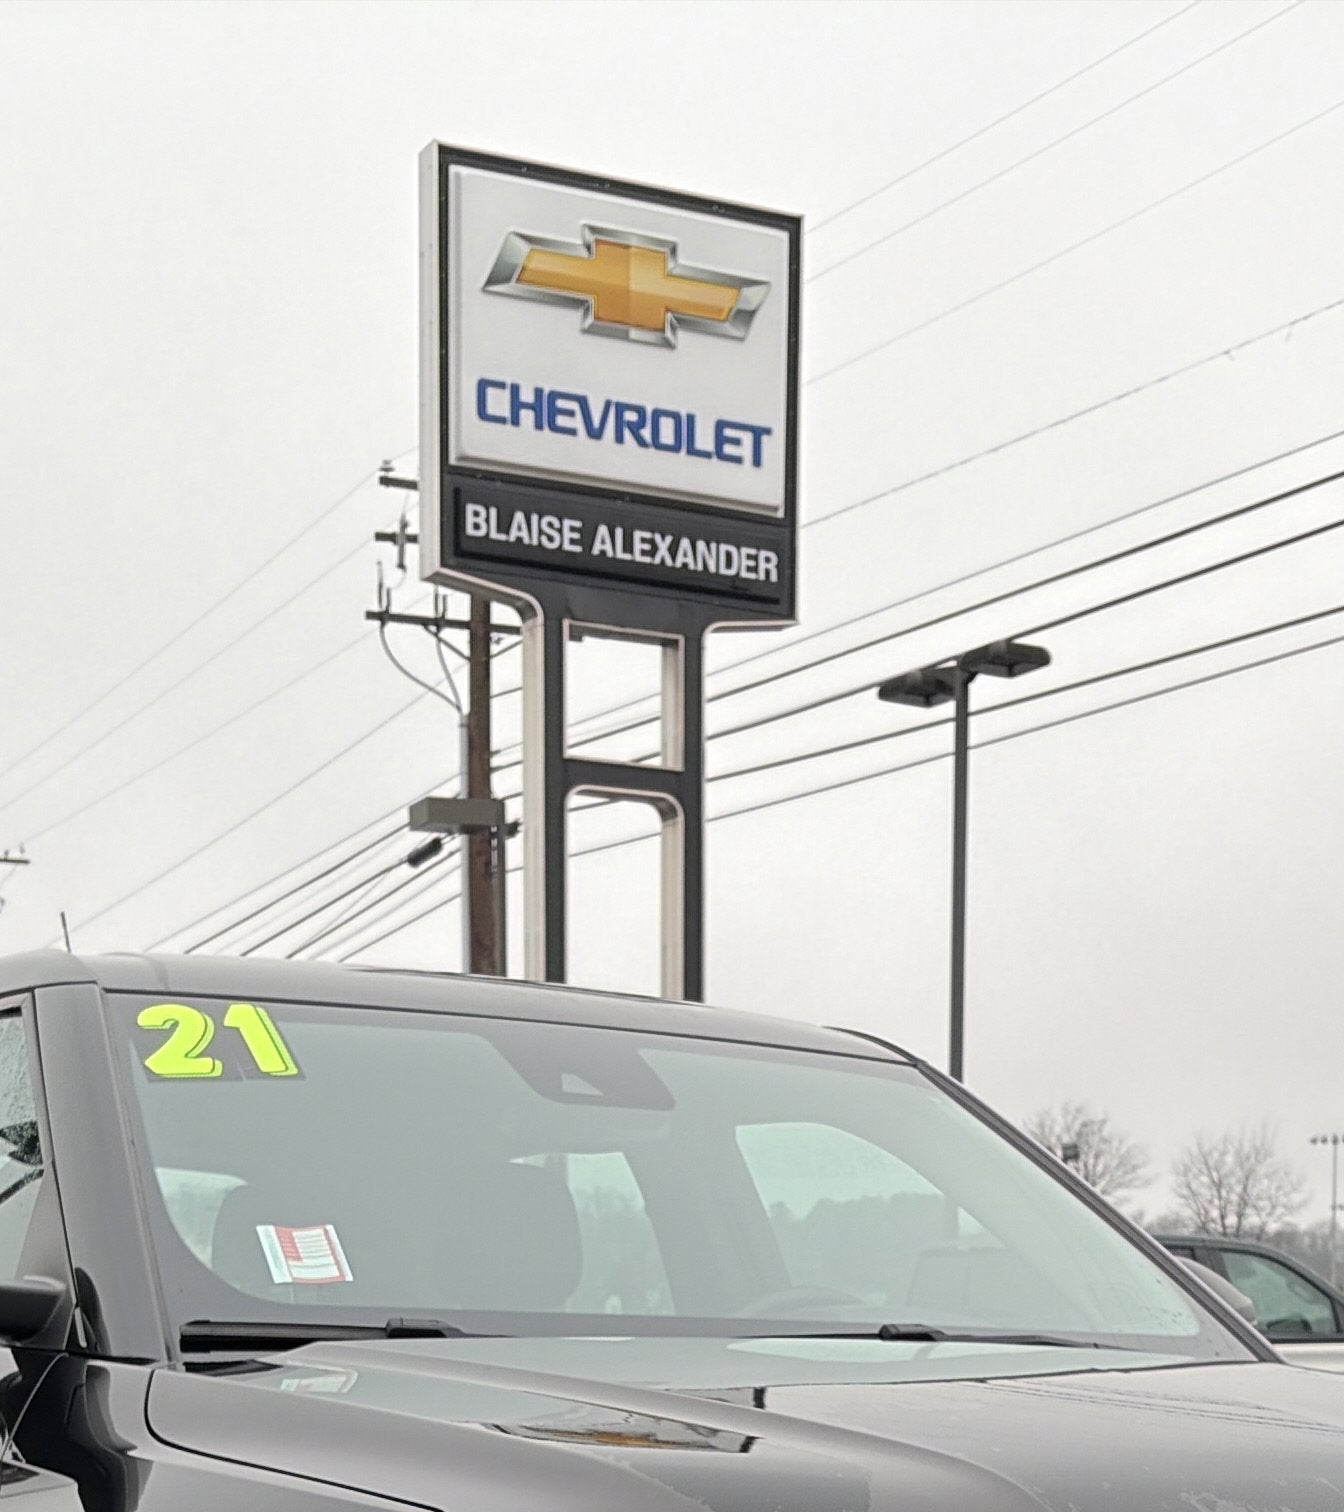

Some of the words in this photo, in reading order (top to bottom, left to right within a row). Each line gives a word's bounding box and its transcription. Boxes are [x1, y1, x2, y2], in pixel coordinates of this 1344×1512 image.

[476, 378, 773, 468] CHEVROLET
[465, 503, 583, 553] BLAISE
[591, 524, 779, 583] ALEXANDER
[136, 1003, 299, 1078] 21
